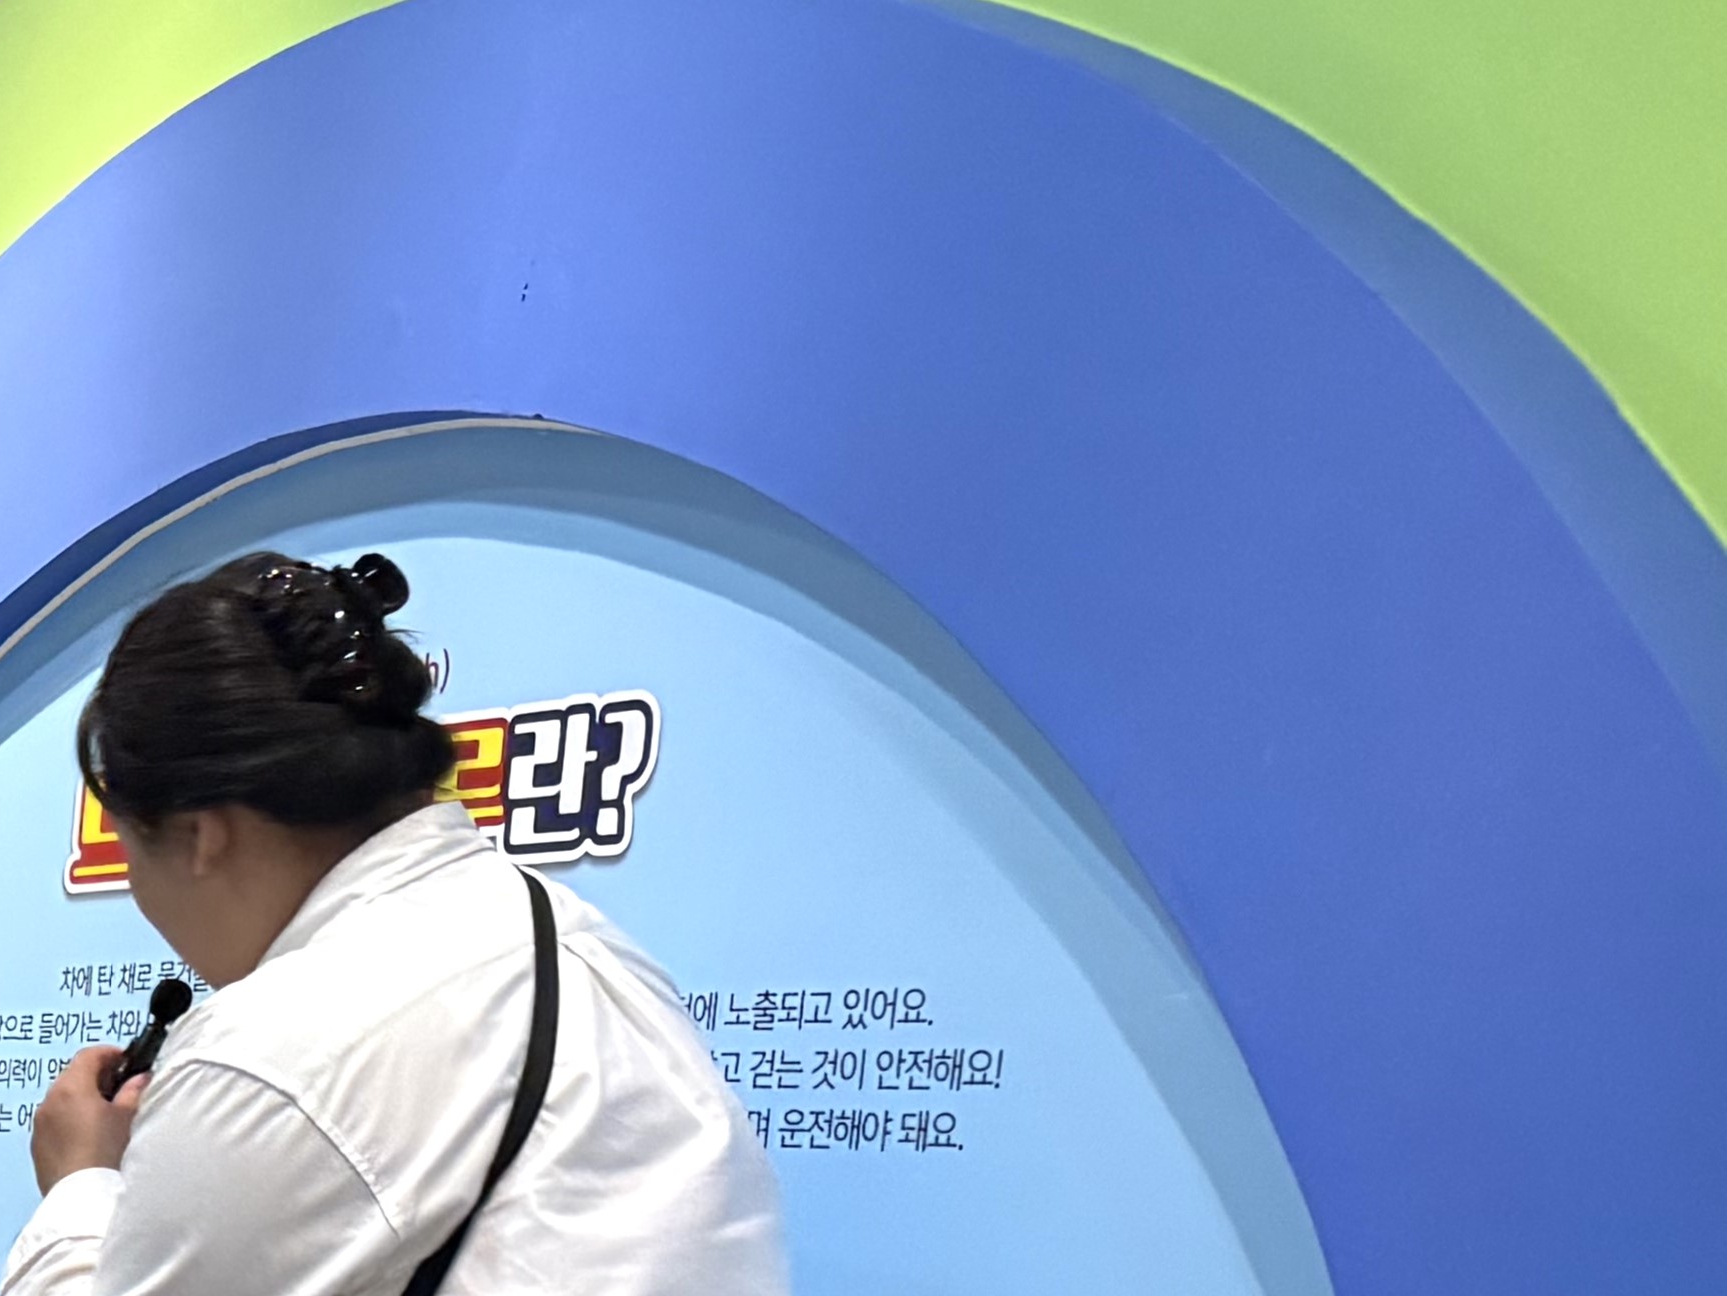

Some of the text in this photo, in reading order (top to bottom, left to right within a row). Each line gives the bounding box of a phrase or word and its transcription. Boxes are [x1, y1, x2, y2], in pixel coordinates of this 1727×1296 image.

[60, 965, 93, 997] 차에
[98, 964, 114, 996] 탄
[118, 962, 152, 994] 채로
[39, 1011, 103, 1044] 들어가는
[106, 1010, 141, 1041] 차와
[724, 989, 832, 1031] 노출되고
[842, 987, 933, 1030] 있어요.
[749, 1050, 804, 1089] 걷는
[811, 1049, 866, 1090] 것이
[876, 1049, 1004, 1091] 안전해요!
[778, 1109, 894, 1152] 운전해야
[897, 1110, 964, 1152] 돼요.
